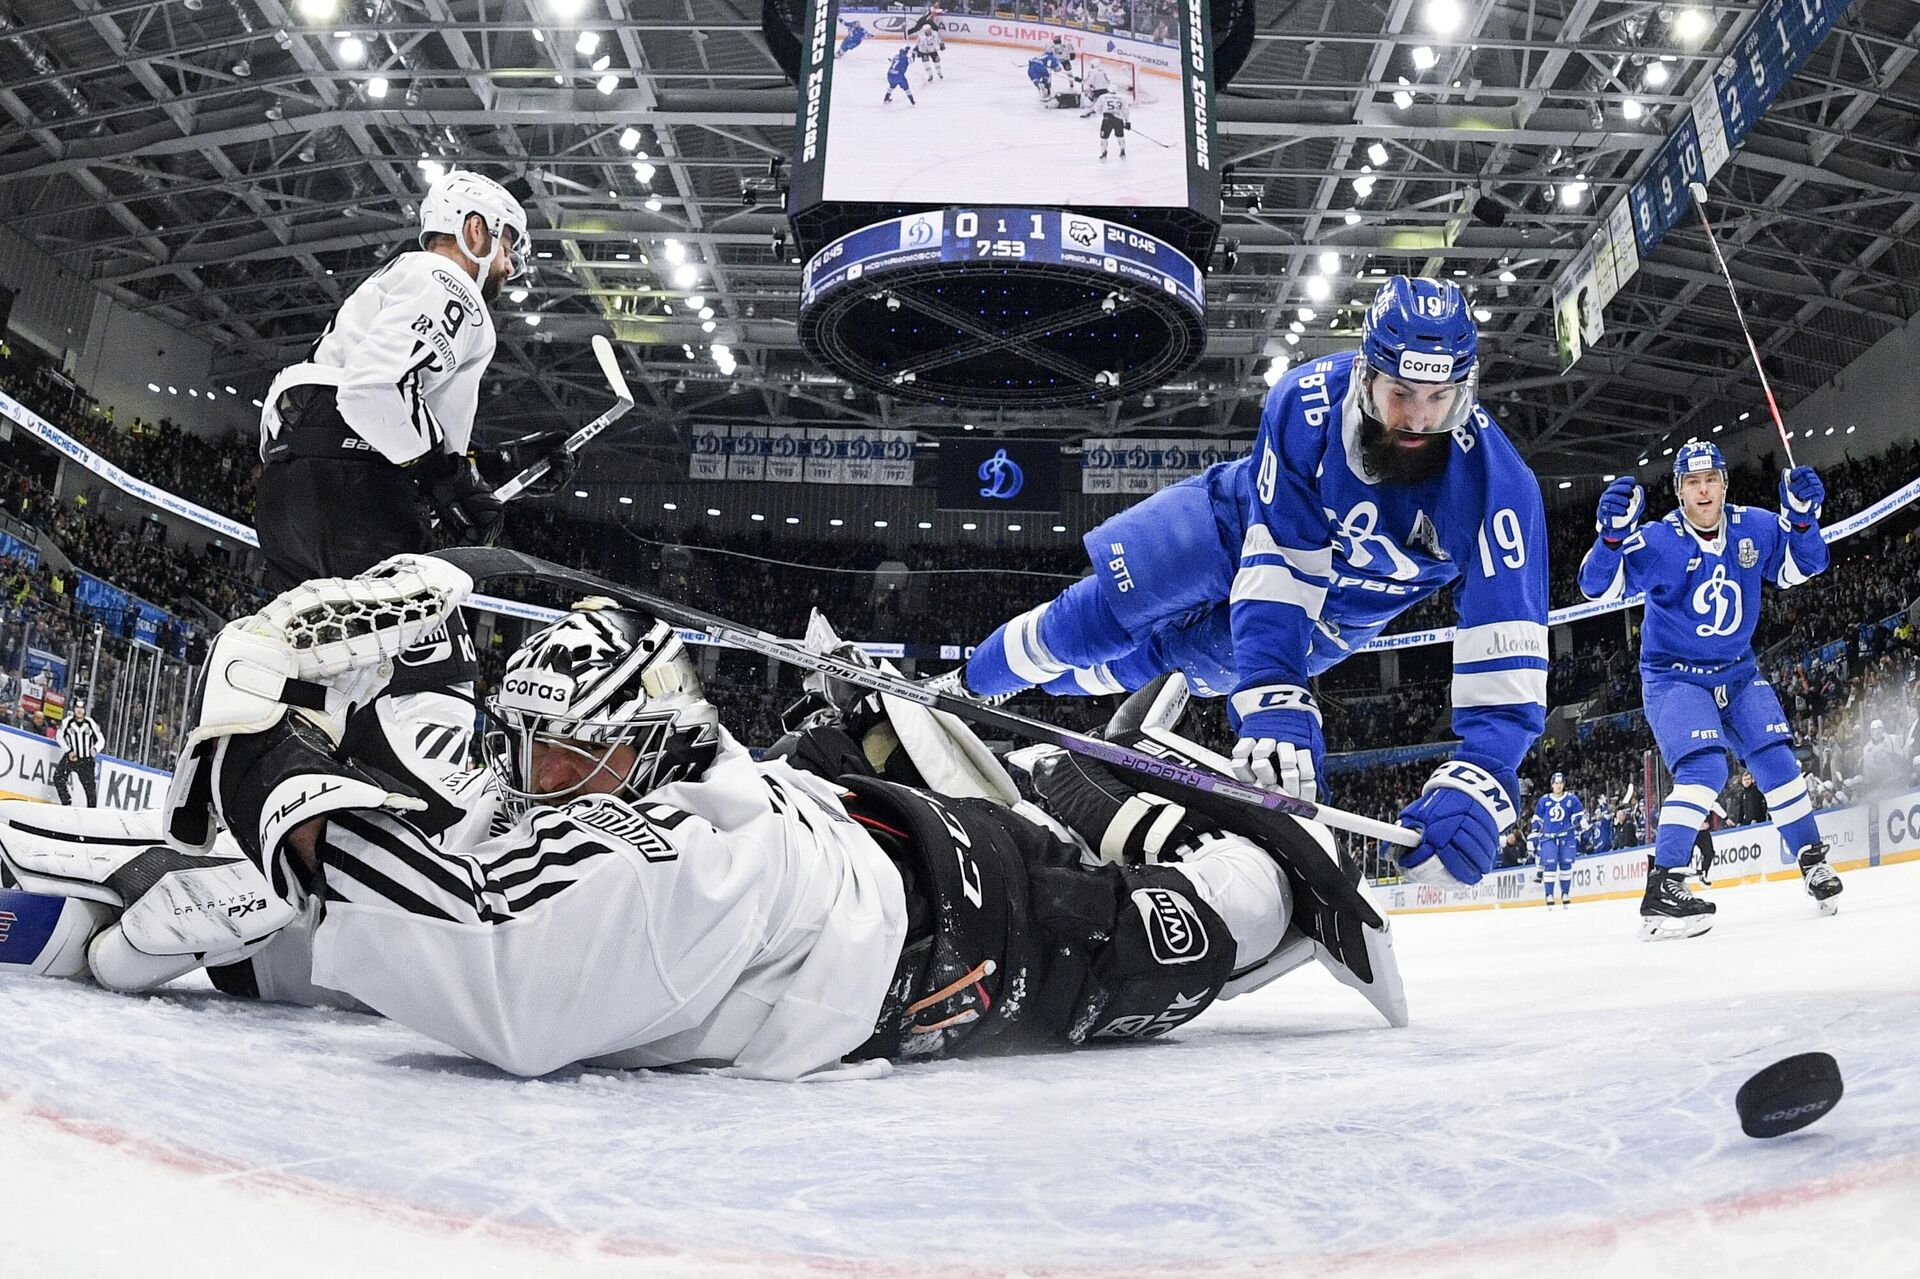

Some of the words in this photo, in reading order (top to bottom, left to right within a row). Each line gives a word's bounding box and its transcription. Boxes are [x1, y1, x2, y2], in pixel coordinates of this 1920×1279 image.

[1750, 50, 1765, 88] 5
[803, 68, 823, 163] МОСКВА
[1727, 85, 1742, 122] 2
[1193, 75, 1210, 171] МОСКВА
[1679, 143, 1697, 186] 10
[1662, 175, 1673, 206] 9
[955, 212, 978, 238] 0
[1029, 214, 1045, 240] 1
[1640, 201, 1651, 232] 8
[976, 240, 1026, 257] 7:53
[1107, 228, 1126, 243] 24
[1129, 234, 1157, 254] 0:45
[440, 299, 465, 340] 9
[1417, 295, 1442, 317] 19
[1402, 359, 1450, 374] согаз
[1299, 371, 1330, 427] ВТБ
[37, 421, 90, 464] ТРАНСНЕФТЬ
[1256, 436, 1278, 505] 19
[1477, 507, 1526, 578] 19
[1109, 556, 1135, 593] ВТБ
[1363, 633, 1436, 650] РАНСНЕФТЬ
[505, 678, 568, 702] согаз
[1258, 690, 1319, 710] CC
[19, 754, 74, 791] LAD
[1122, 755, 1200, 786] RIBCOR
[1572, 868, 1591, 887] газ
[174, 891, 256, 916] CATALYST
[228, 898, 267, 918] PX3
[1417, 885, 1447, 905] FONBET
